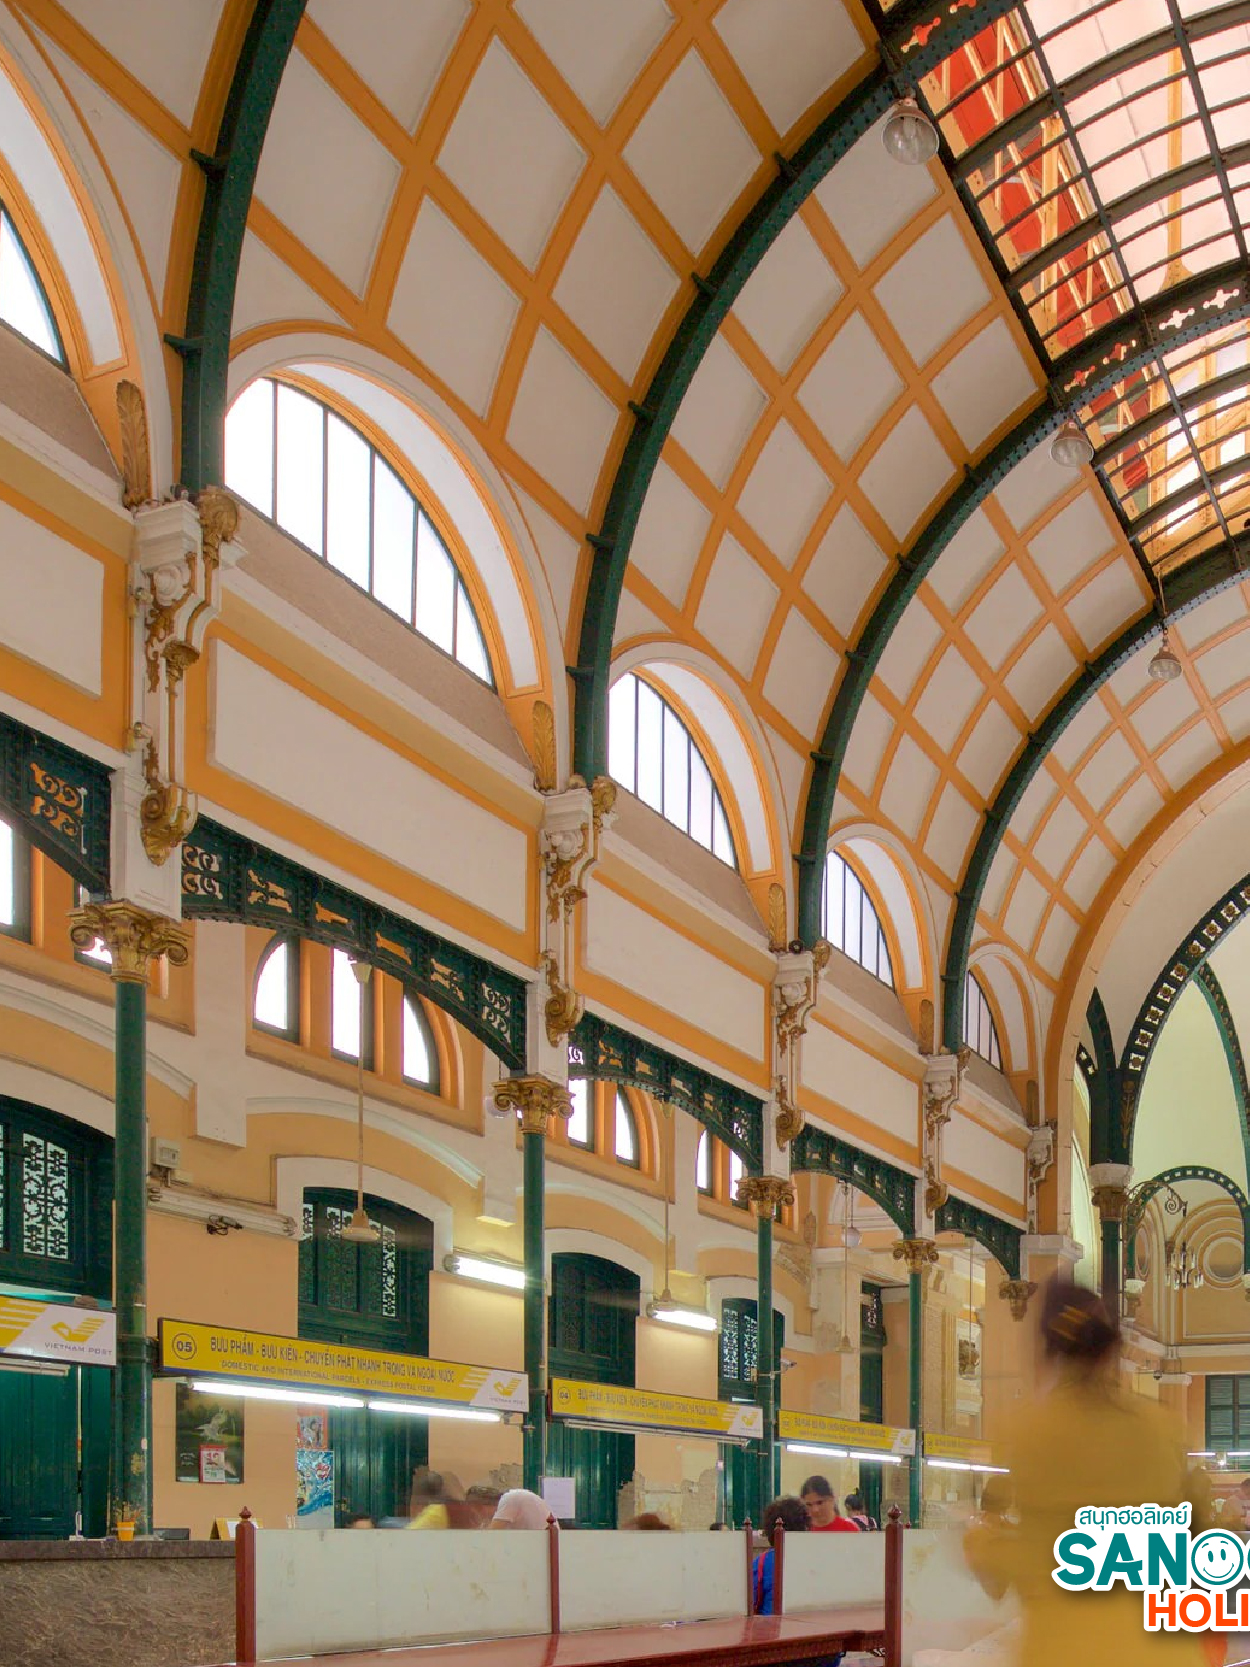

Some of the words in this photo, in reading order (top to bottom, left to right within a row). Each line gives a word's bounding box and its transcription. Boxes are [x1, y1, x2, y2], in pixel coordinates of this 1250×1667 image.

[44, 1342, 85, 1353] VIETNAM
[88, 1347, 113, 1356] POST
[176, 1340, 193, 1353] 05
[221, 1359, 259, 1372] DOMESTIC
[261, 1366, 276, 1375] AND
[356, 1355, 382, 1372] NHANH
[382, 1360, 406, 1377] TRONG
